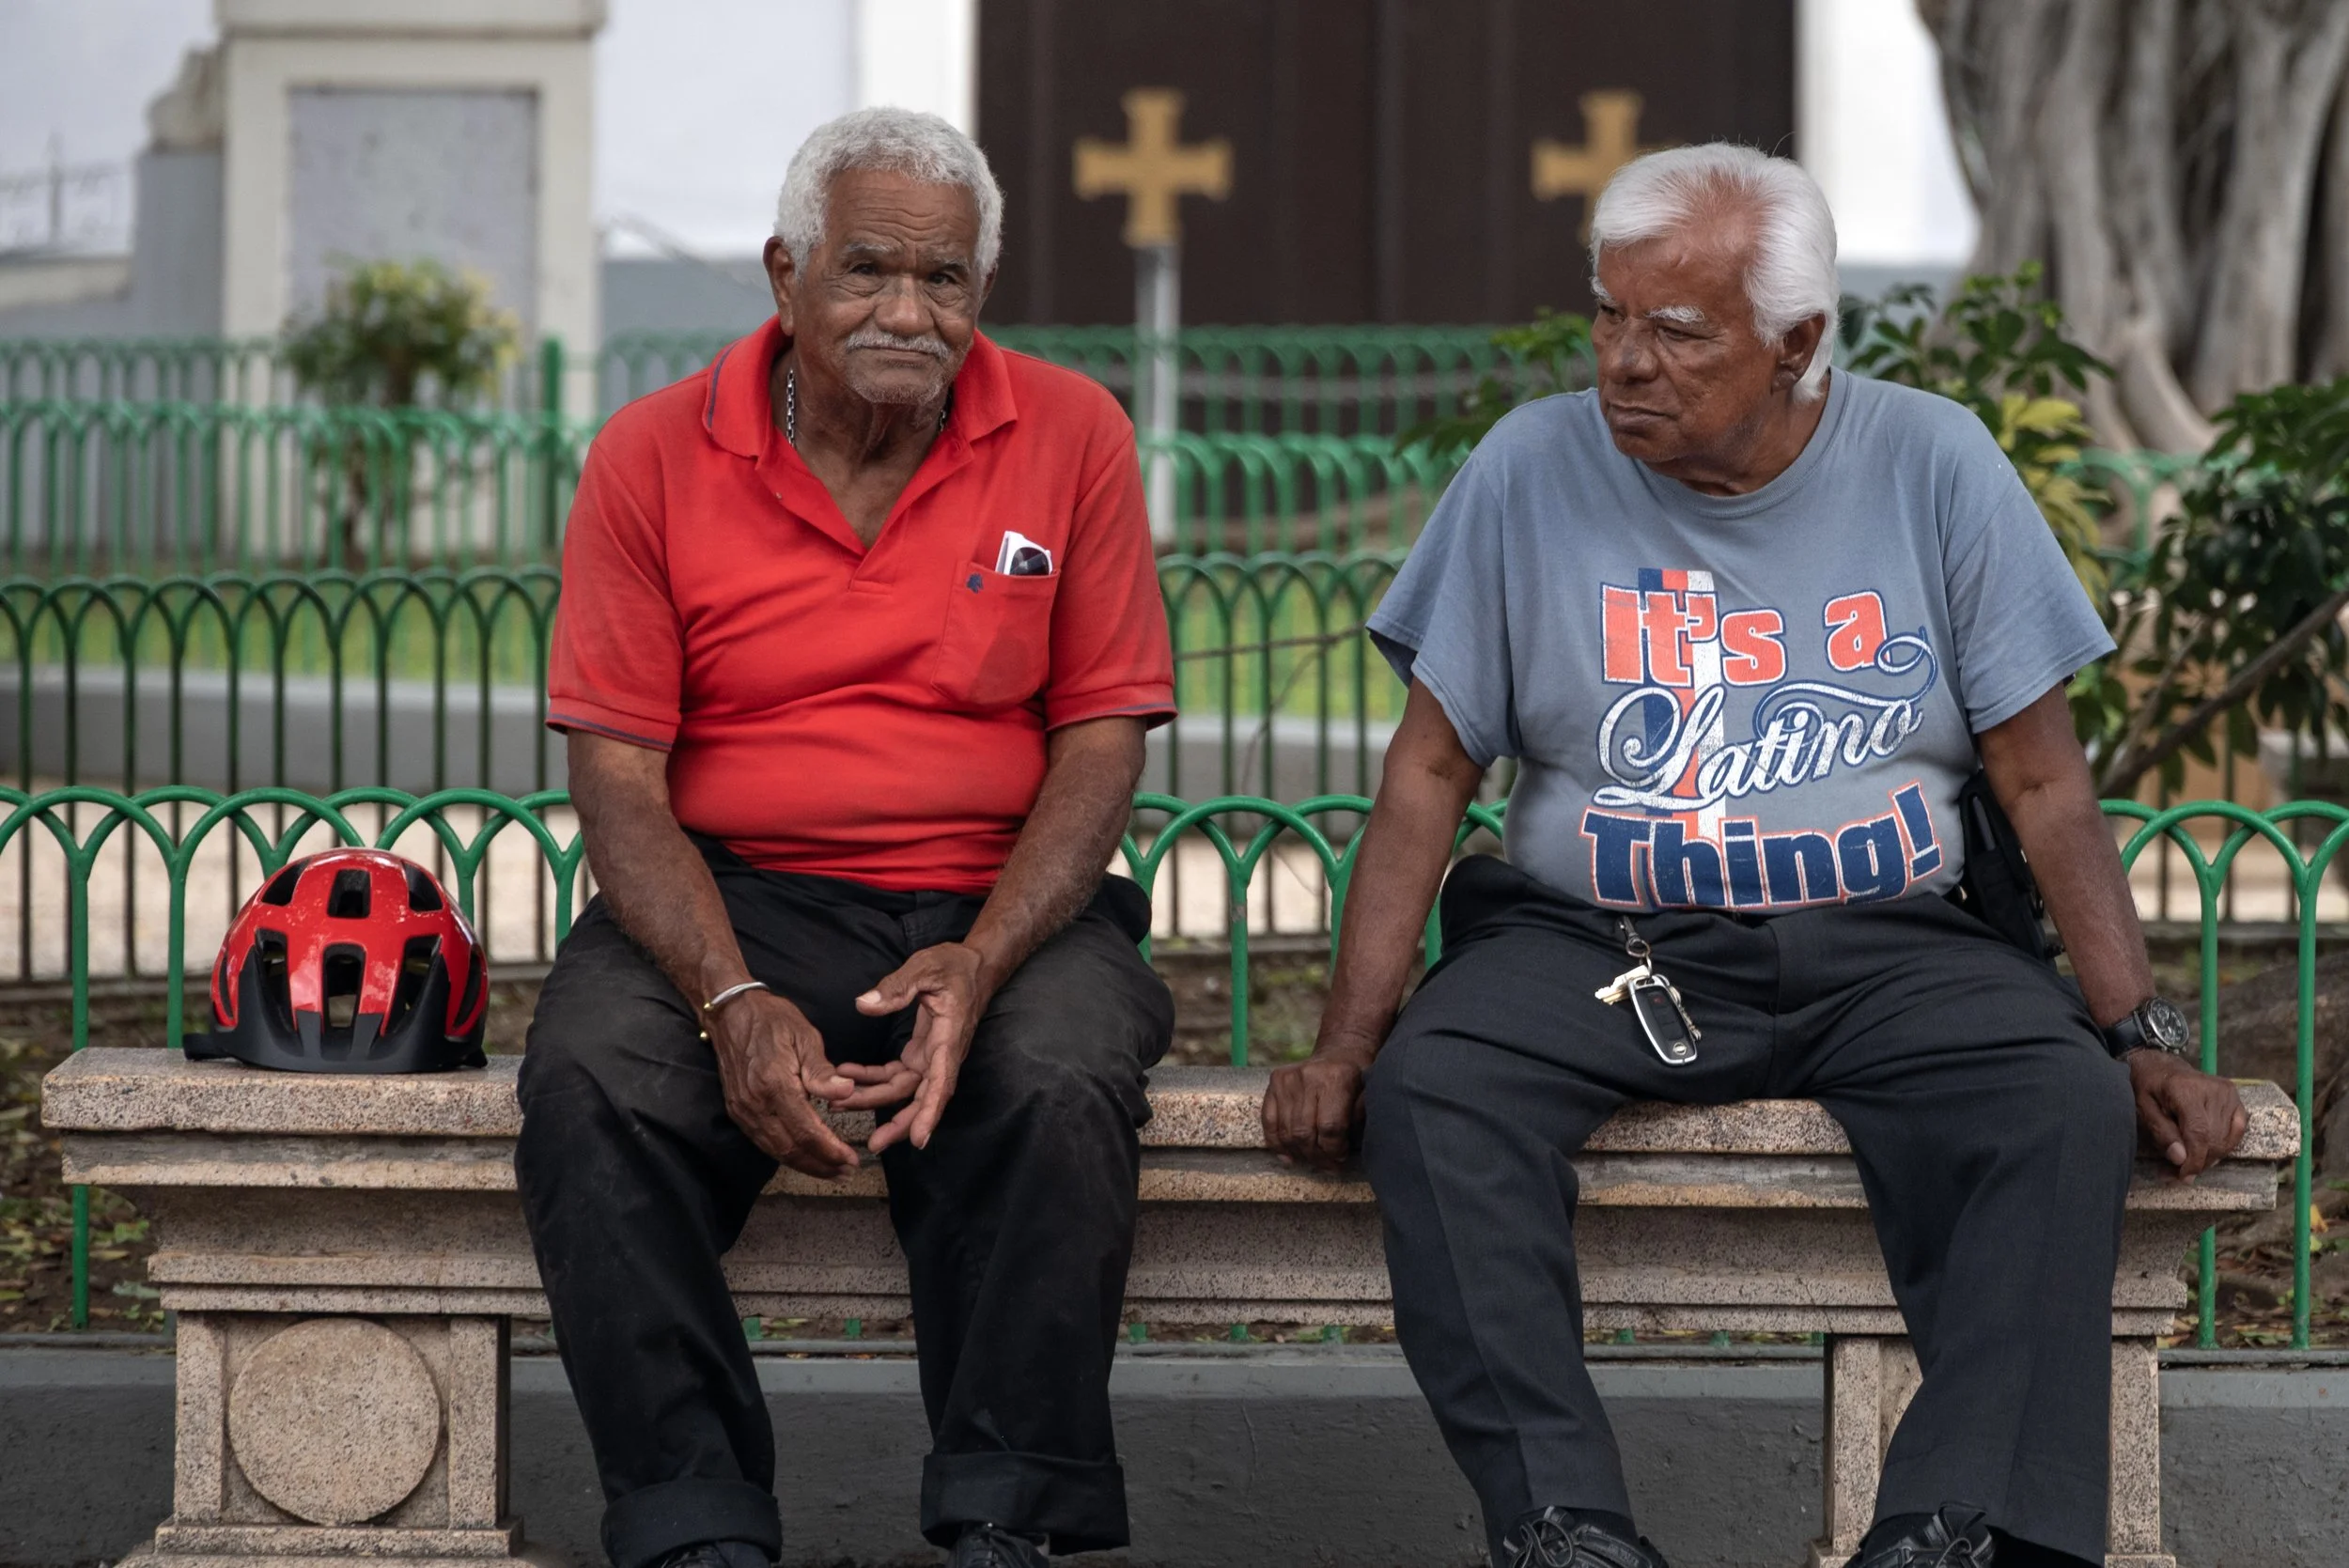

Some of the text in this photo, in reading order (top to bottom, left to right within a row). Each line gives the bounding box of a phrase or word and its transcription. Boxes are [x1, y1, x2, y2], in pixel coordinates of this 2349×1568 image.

[1602, 583, 1888, 687] It's a
[1591, 626, 1938, 812] Latino
[1579, 781, 1944, 909] Thing!
